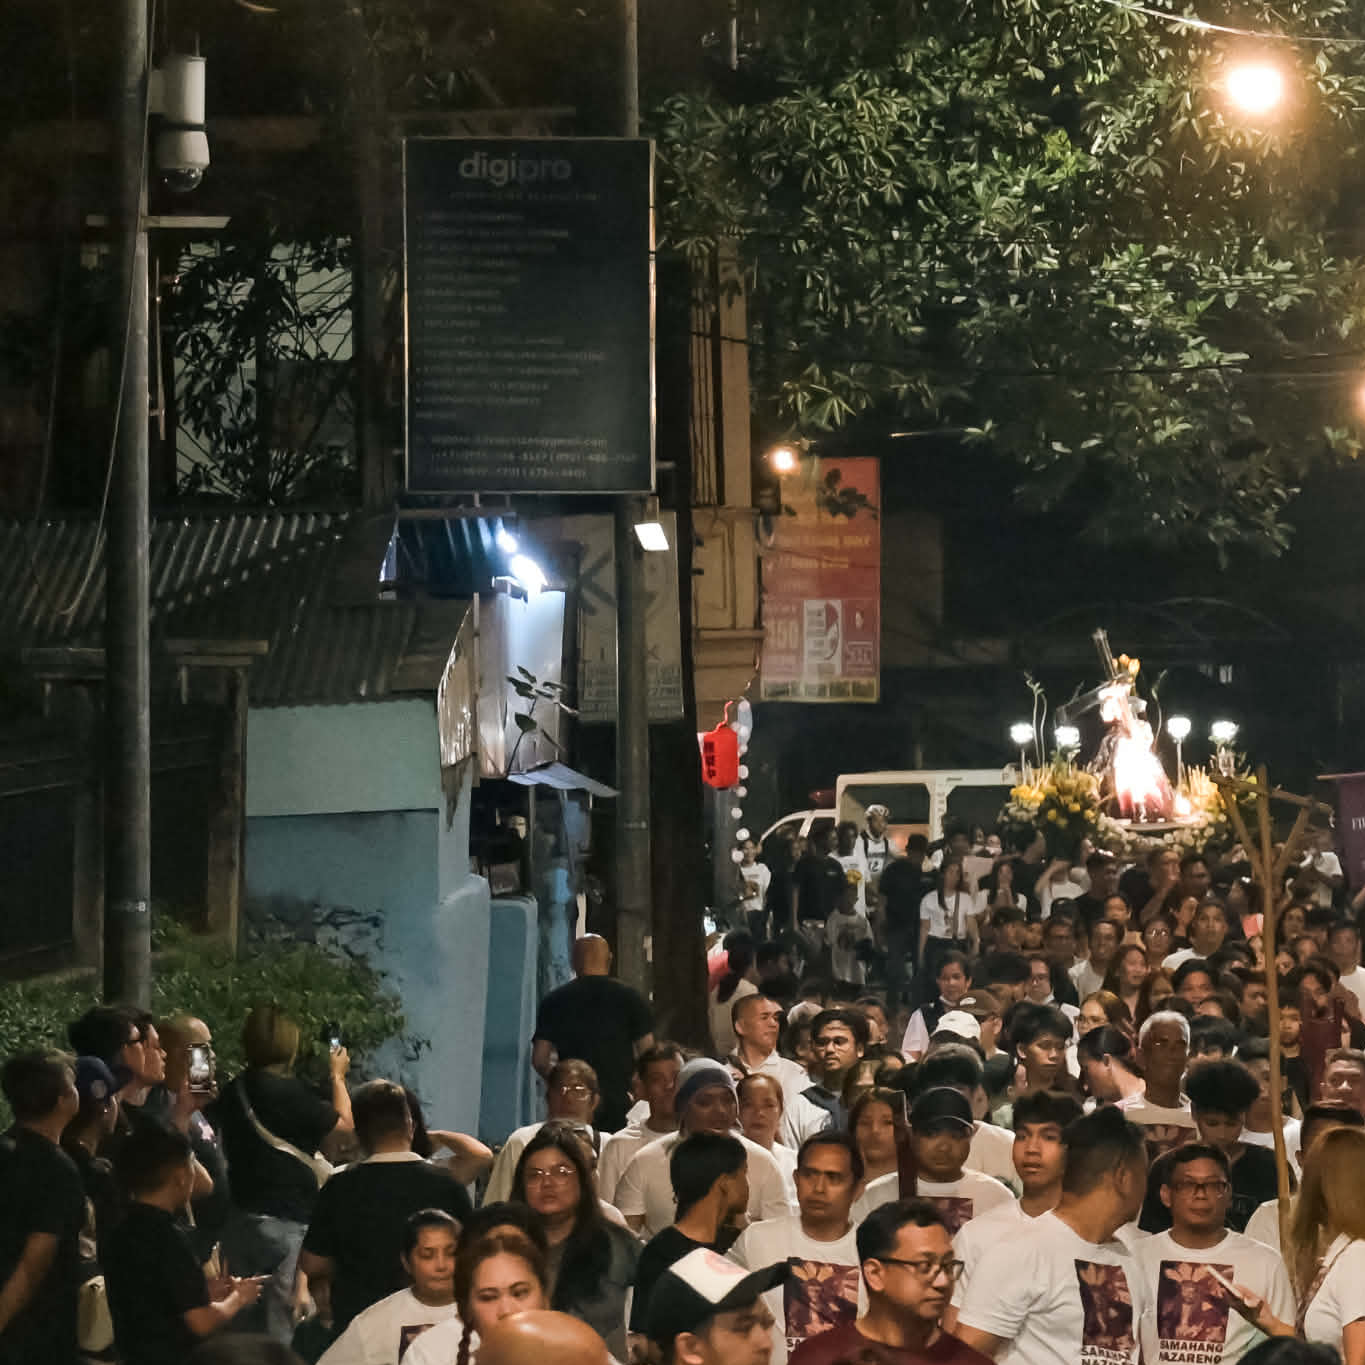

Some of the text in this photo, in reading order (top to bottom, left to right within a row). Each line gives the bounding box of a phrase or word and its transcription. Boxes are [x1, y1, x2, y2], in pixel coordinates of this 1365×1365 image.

[459, 151, 572, 187] digipro
[1159, 1339, 1224, 1354] SAMAHANG
[1158, 1351, 1222, 1365] NAZARENO
